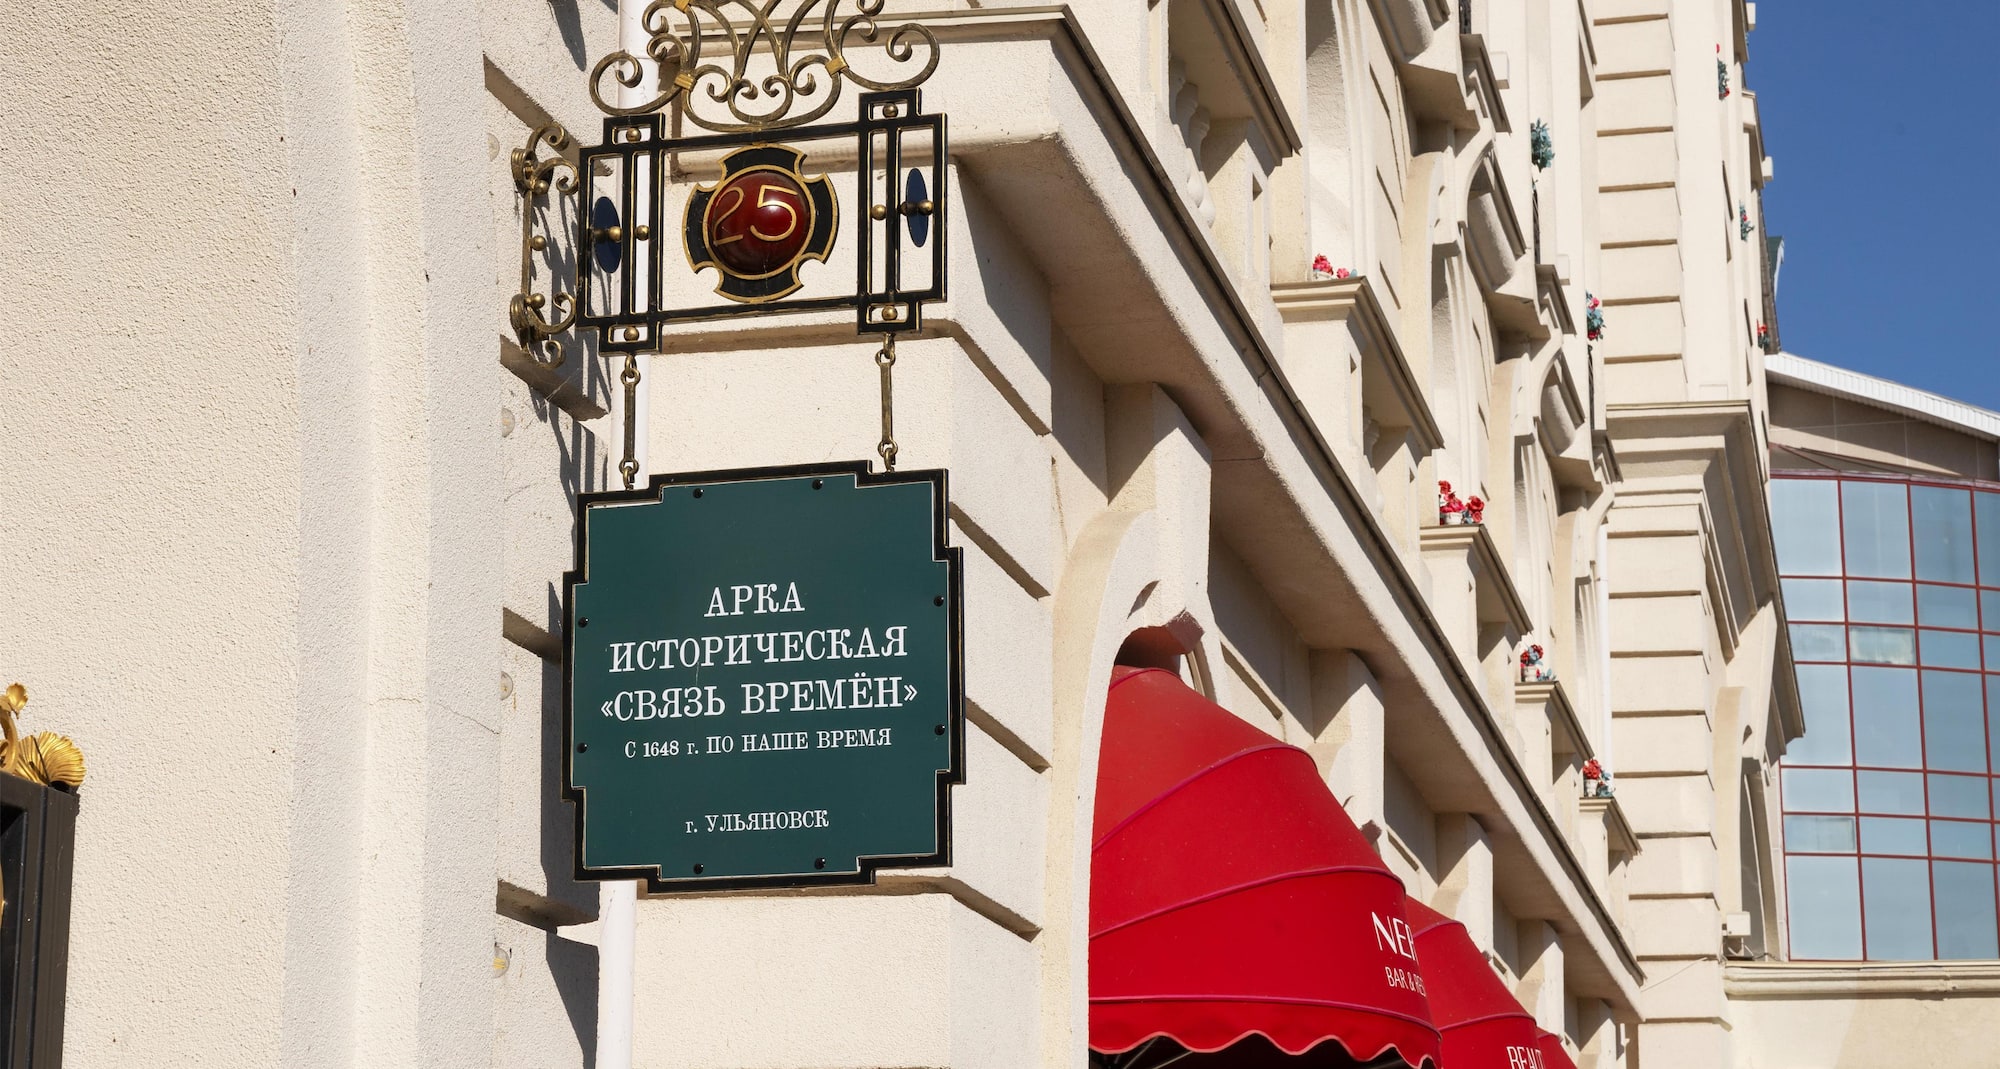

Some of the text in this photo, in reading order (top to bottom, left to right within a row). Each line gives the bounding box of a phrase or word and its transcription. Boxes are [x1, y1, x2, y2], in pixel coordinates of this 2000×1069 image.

[712, 184, 798, 246] 25
[703, 581, 805, 618] АРКА
[608, 625, 908, 673] ИСТОРИЧЕСКАЯ
[600, 671, 918, 722] «СВЯЗЬ ВРЕМЁН»
[624, 727, 892, 759] С 1648 г. ПО НАШЕ ВРЕМЯ
[684, 809, 830, 834] г. УЛЬЯНОВСК
[1384, 966, 1409, 990] BAR
[1406, 971, 1417, 992] &
